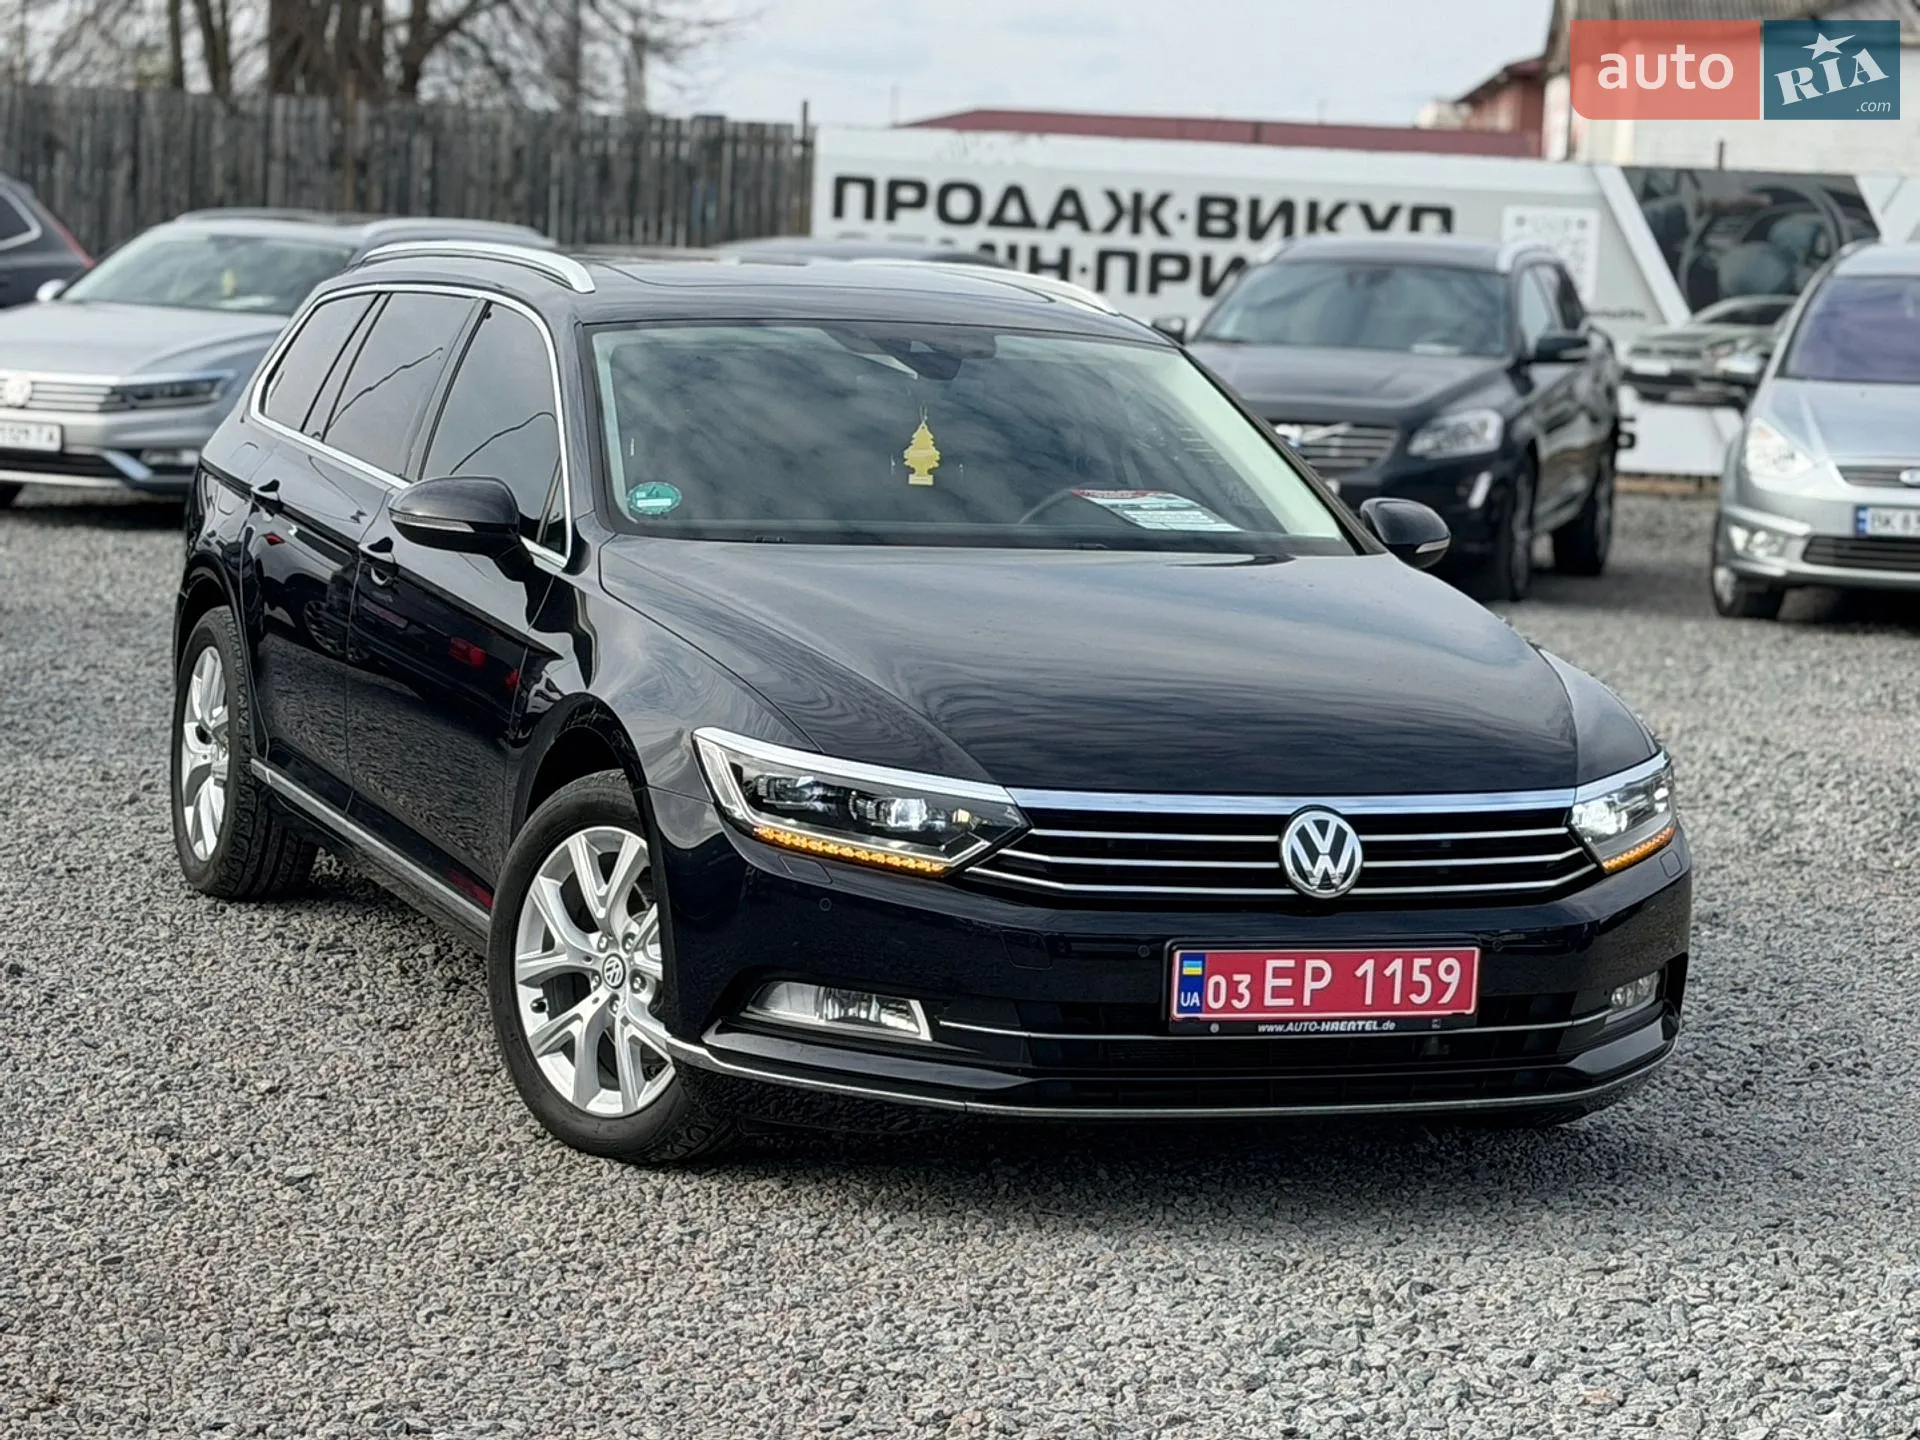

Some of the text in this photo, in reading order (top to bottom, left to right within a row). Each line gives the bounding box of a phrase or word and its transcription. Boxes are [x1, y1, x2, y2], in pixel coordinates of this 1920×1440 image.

[1180, 991, 1201, 1008] UA
[1206, 957, 1461, 1010] 03 EP 1159
